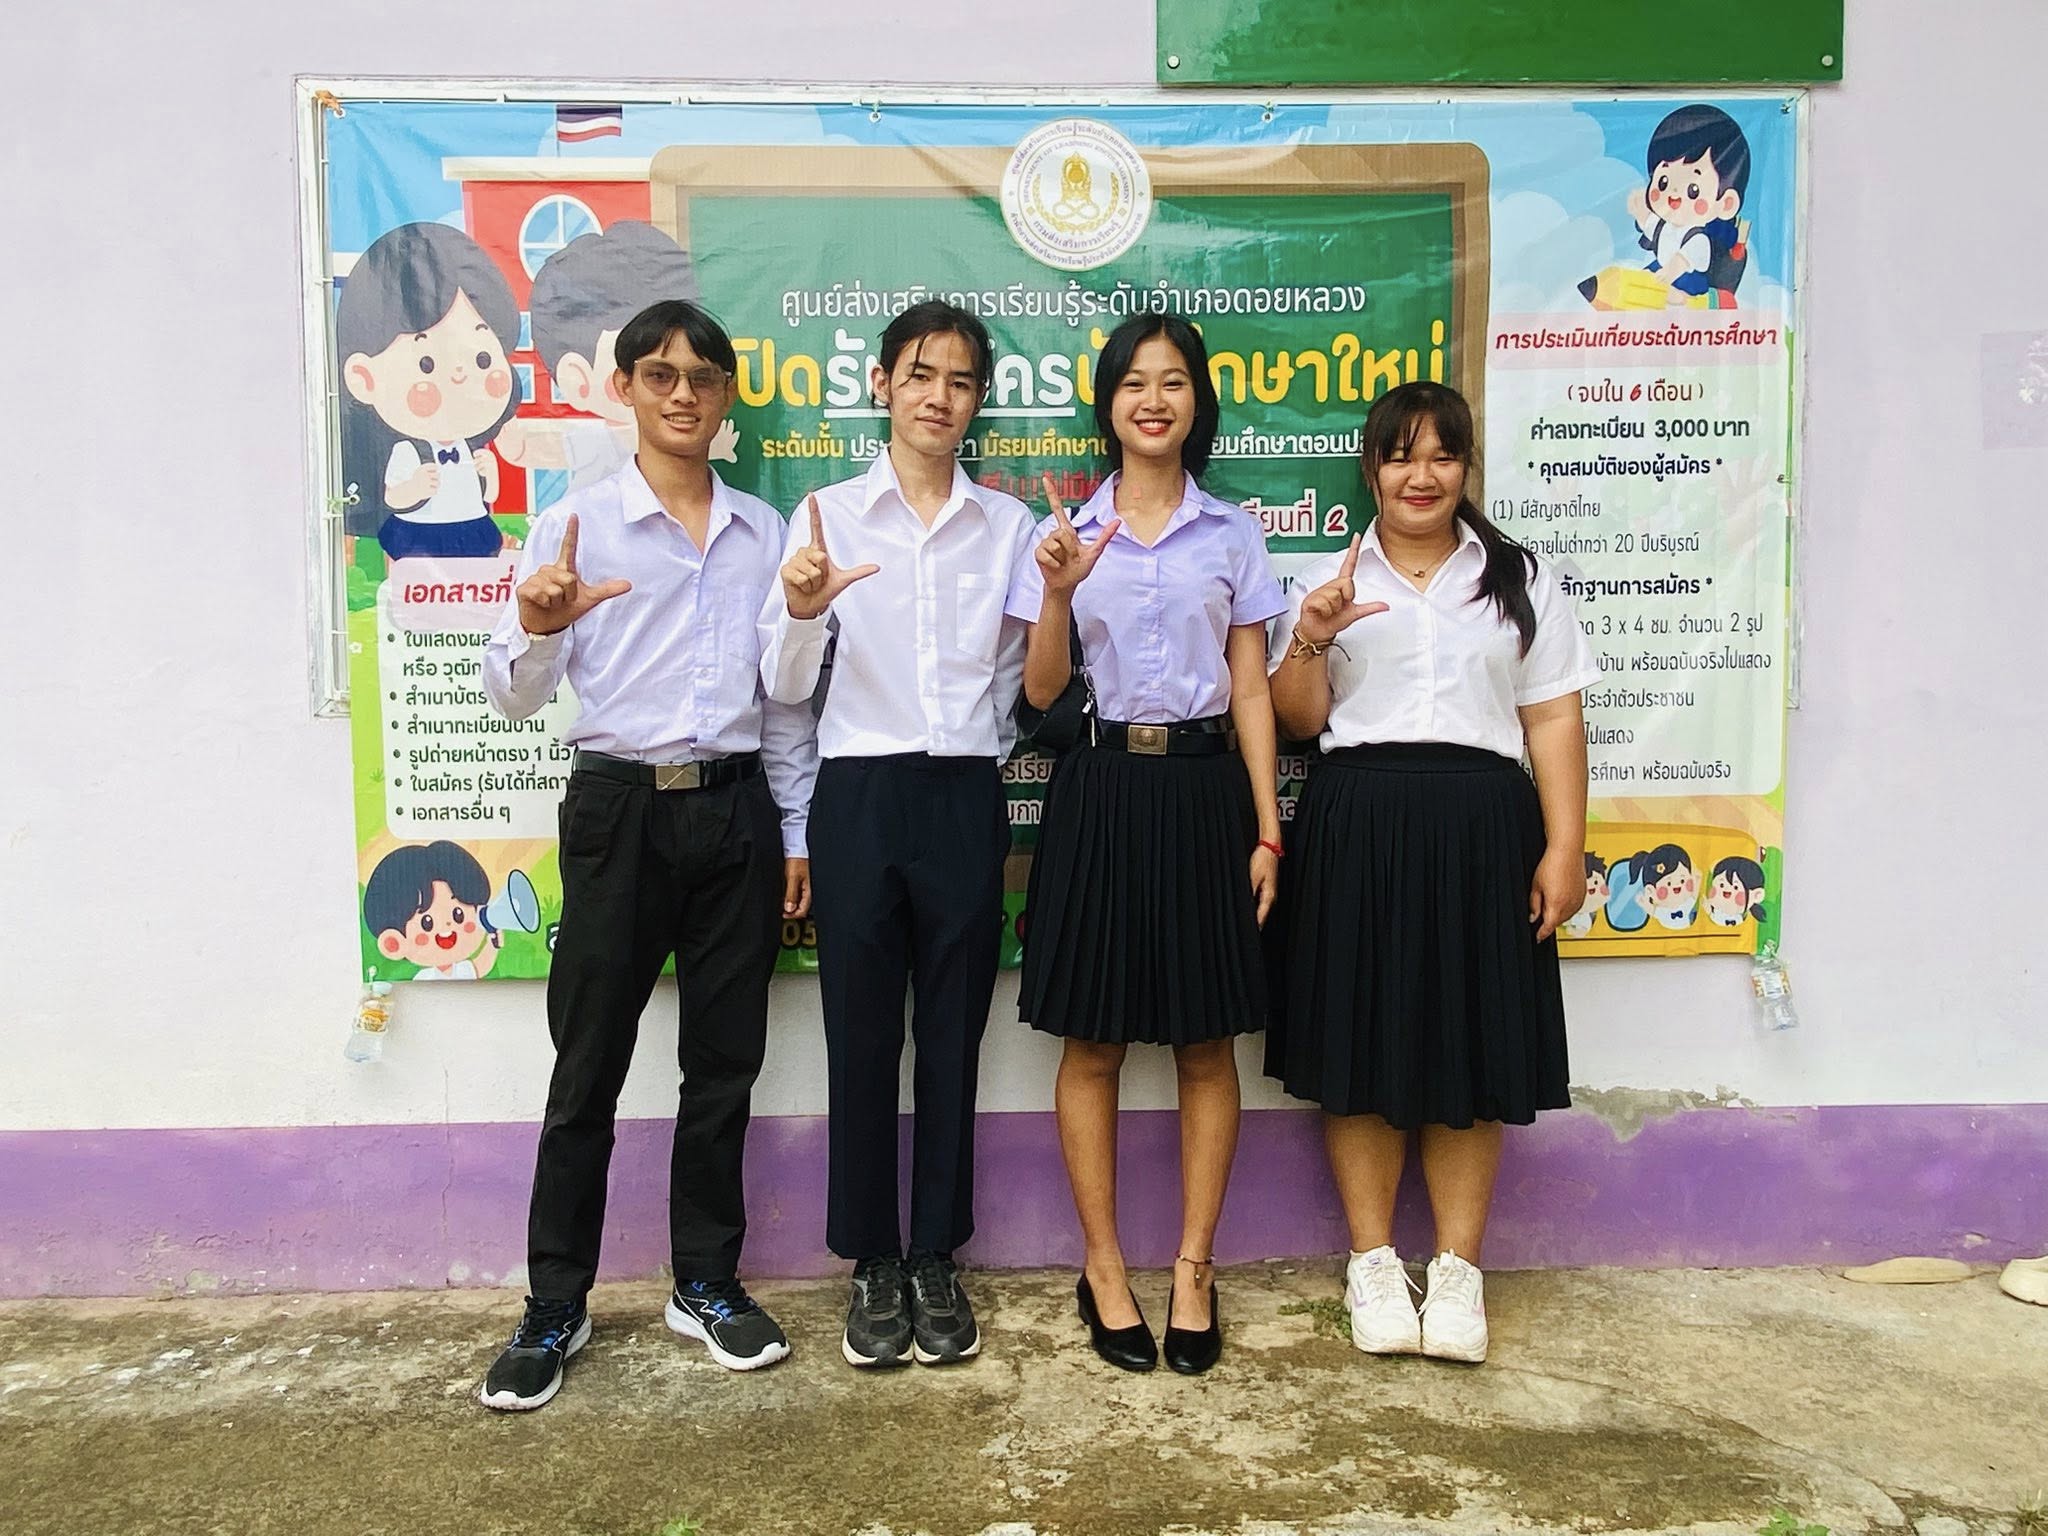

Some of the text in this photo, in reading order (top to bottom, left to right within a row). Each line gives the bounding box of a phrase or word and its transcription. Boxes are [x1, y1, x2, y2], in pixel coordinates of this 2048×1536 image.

[782, 279, 1366, 327] ศูนย์ส่งเสริการเรียนรู้ระดับอำเภอดอยหลวง
[1495, 321, 1778, 349] การประเมินเทียบระดับการศึกษา
[1629, 384, 1643, 402] 6
[762, 421, 844, 458] ระดับชั้น
[1530, 416, 1750, 442] ค่าลงทะเบียน 3,000 บาท
[1326, 508, 1345, 533] 2
[1492, 494, 1601, 521] (1) มีสัญชาติไทย
[1614, 533, 1634, 553] 20
[1641, 531, 1700, 557] ปีบริบูรณ์
[403, 564, 516, 603] เอกสารที่
[1560, 573, 1701, 601] ลักฐานการสมัคร
[1601, 615, 1612, 635] 3
[1618, 619, 1627, 635] x
[1633, 614, 1644, 634] 4
[1678, 613, 1723, 634] จำนวน
[1730, 612, 1740, 632] 2
[1746, 612, 1763, 637] รูป
[402, 656, 438, 676] หรือ
[1631, 645, 1772, 671] พร้อมฉบับจริงไปแสดง
[409, 741, 529, 770] รูปถ่ายหน้าตรง
[534, 746, 542, 761] 1
[410, 764, 568, 793] ใบสมัคร (รับได้ที่สถา
[1643, 759, 1731, 780] พร้อมฉบับจริง
[412, 794, 494, 821] เอกสารอื่น
